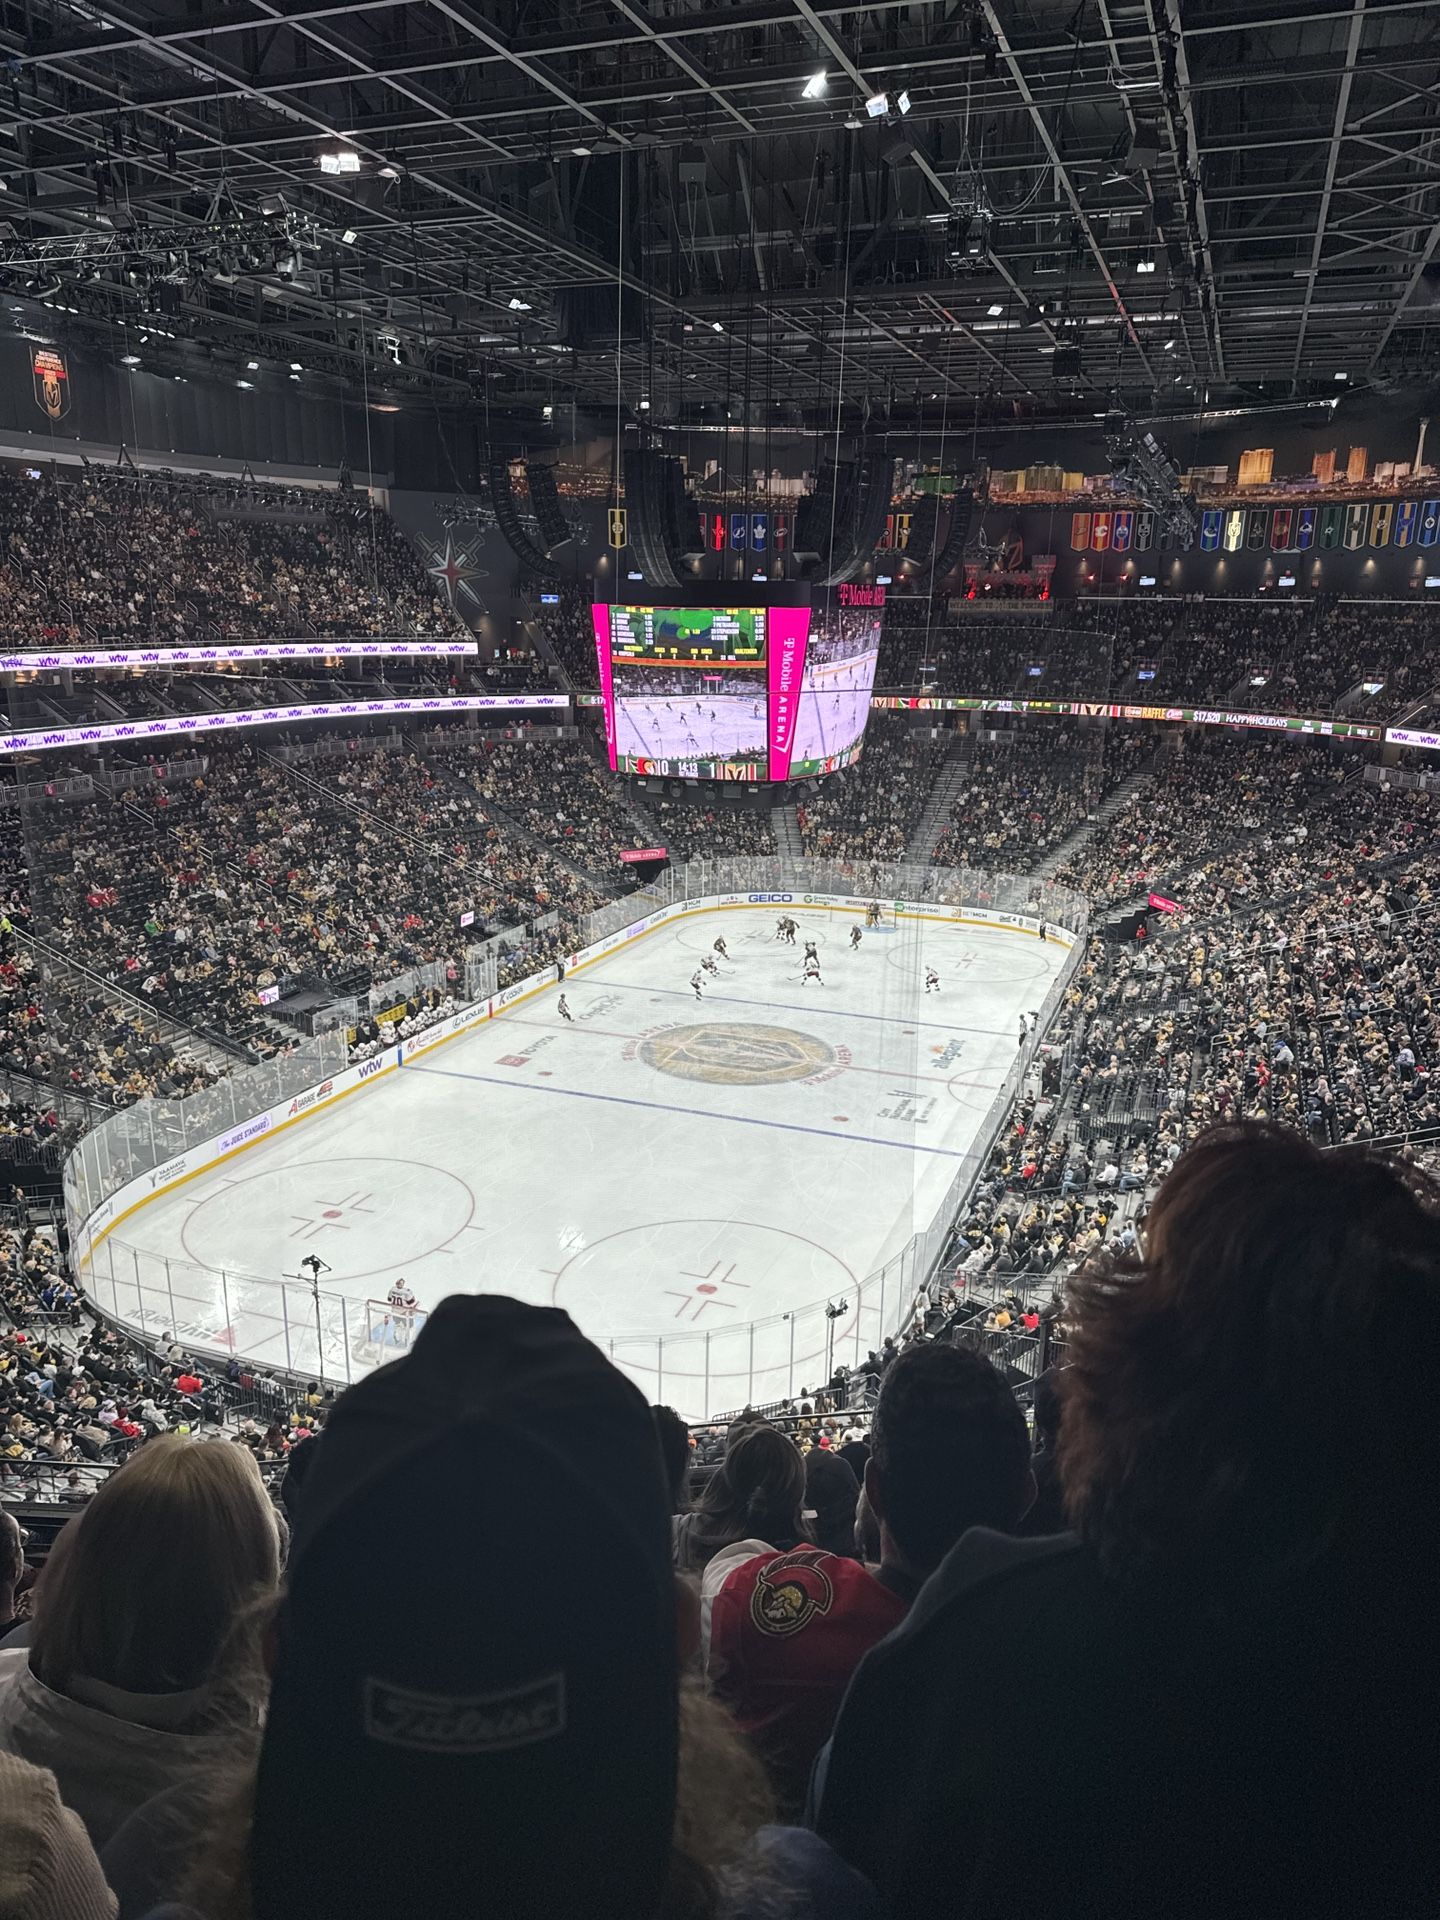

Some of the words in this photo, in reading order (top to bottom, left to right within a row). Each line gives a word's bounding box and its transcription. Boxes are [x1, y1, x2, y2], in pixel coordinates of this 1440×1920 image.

[780, 650, 794, 693] Mobile
[775, 697, 788, 744] ARENA
[1225, 714, 1250, 725] HAPPY
[1252, 716, 1288, 728] HOLIDAYS
[661, 759, 669, 775] 0
[678, 762, 698, 773] 14:13
[709, 763, 715, 778] 1
[748, 894, 793, 903] GEICO
[461, 1006, 485, 1025] LEXUS
[518, 1034, 559, 1056] TOYOTA
[358, 1058, 383, 1079] wtw
